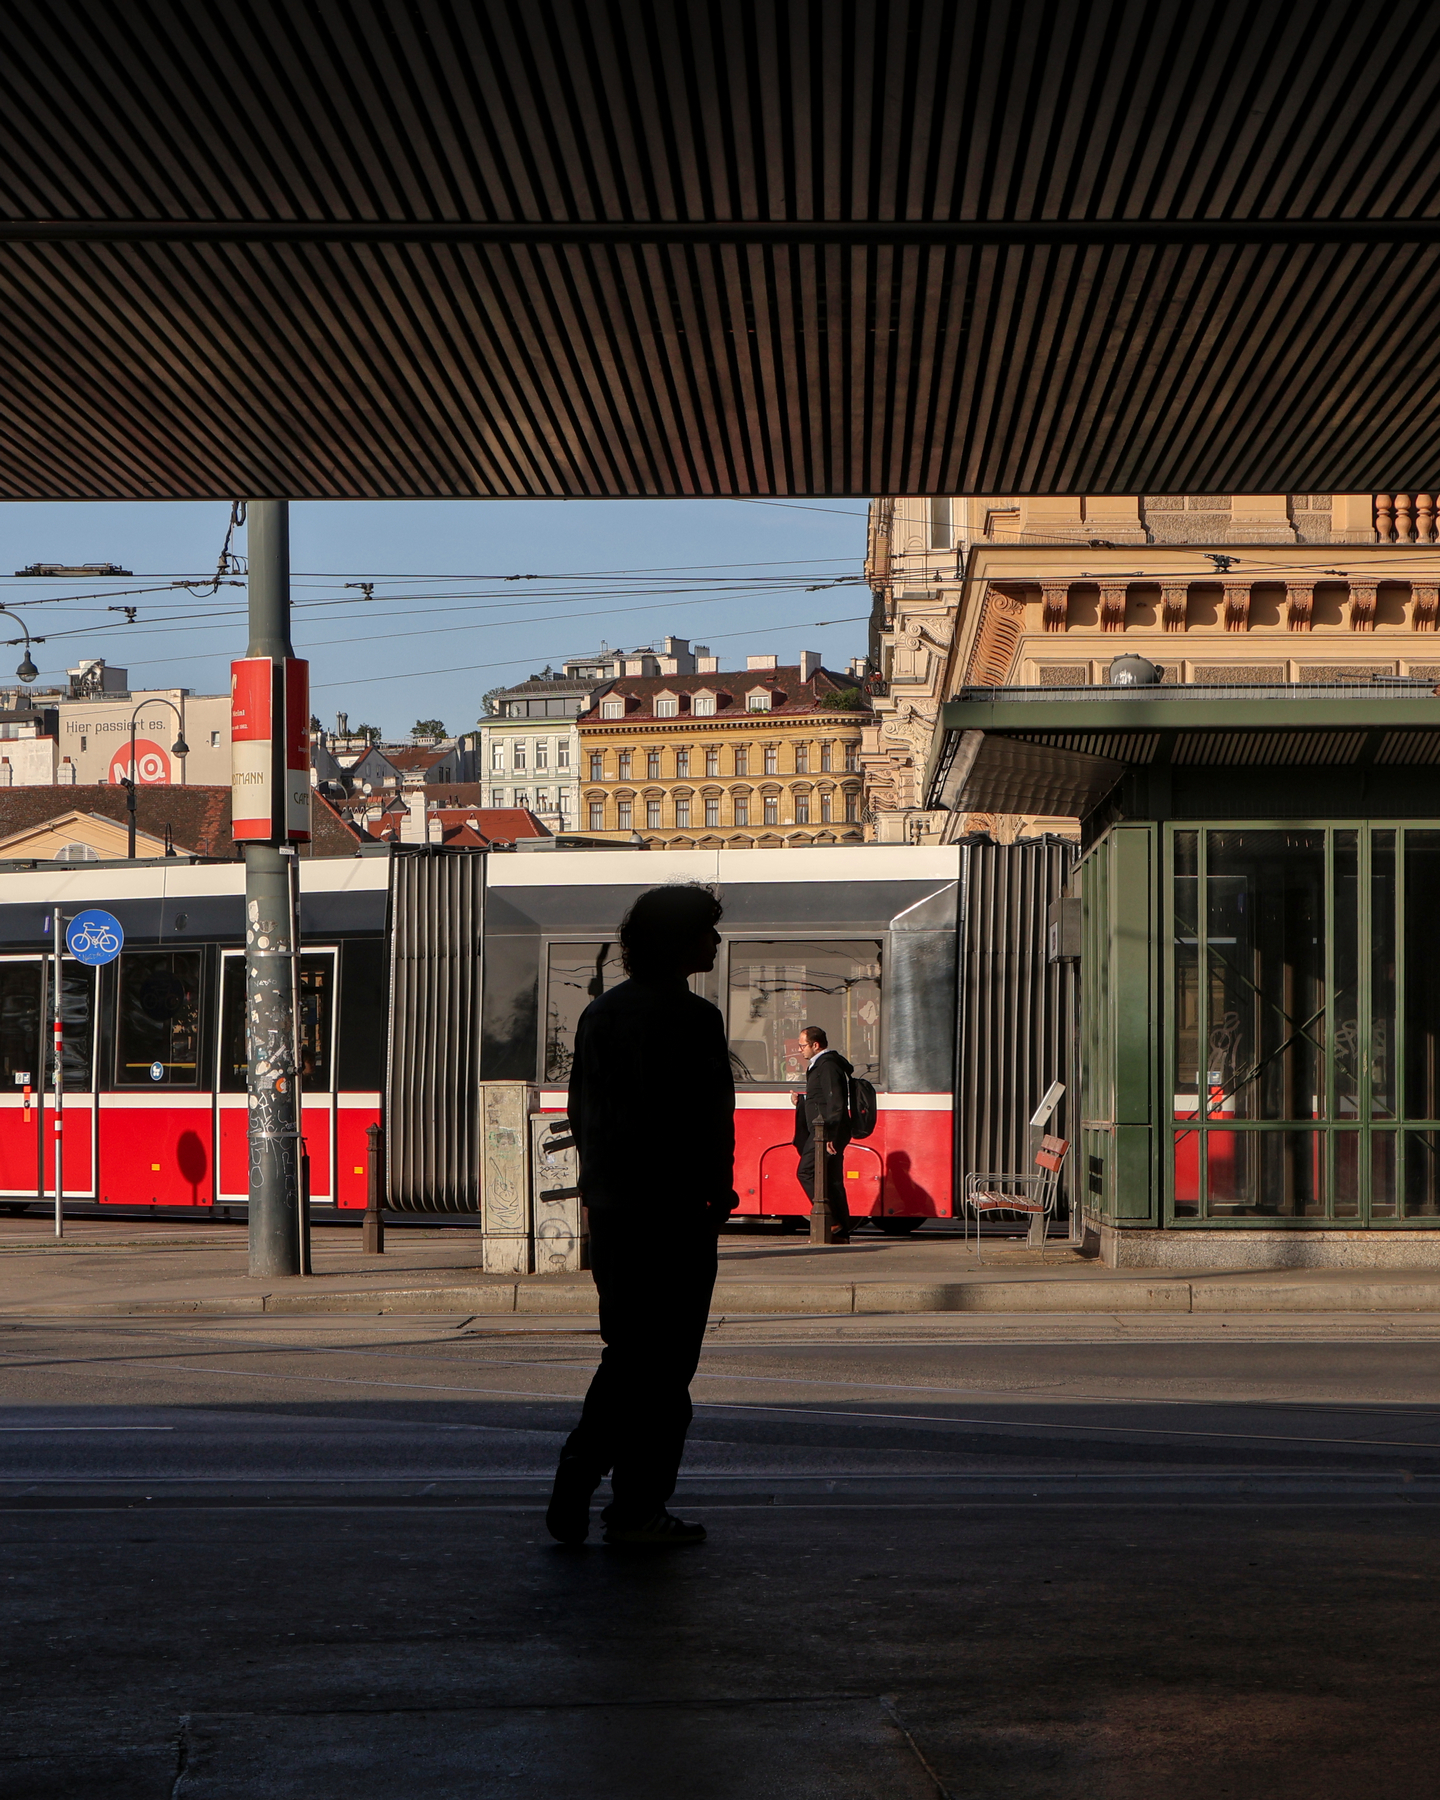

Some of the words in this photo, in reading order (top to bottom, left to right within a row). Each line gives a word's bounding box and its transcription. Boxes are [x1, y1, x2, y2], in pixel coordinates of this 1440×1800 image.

[66, 721, 91, 733] Hier
[95, 719, 145, 734] passiert
[149, 720, 166, 730] es.
[113, 753, 166, 784] MQ
